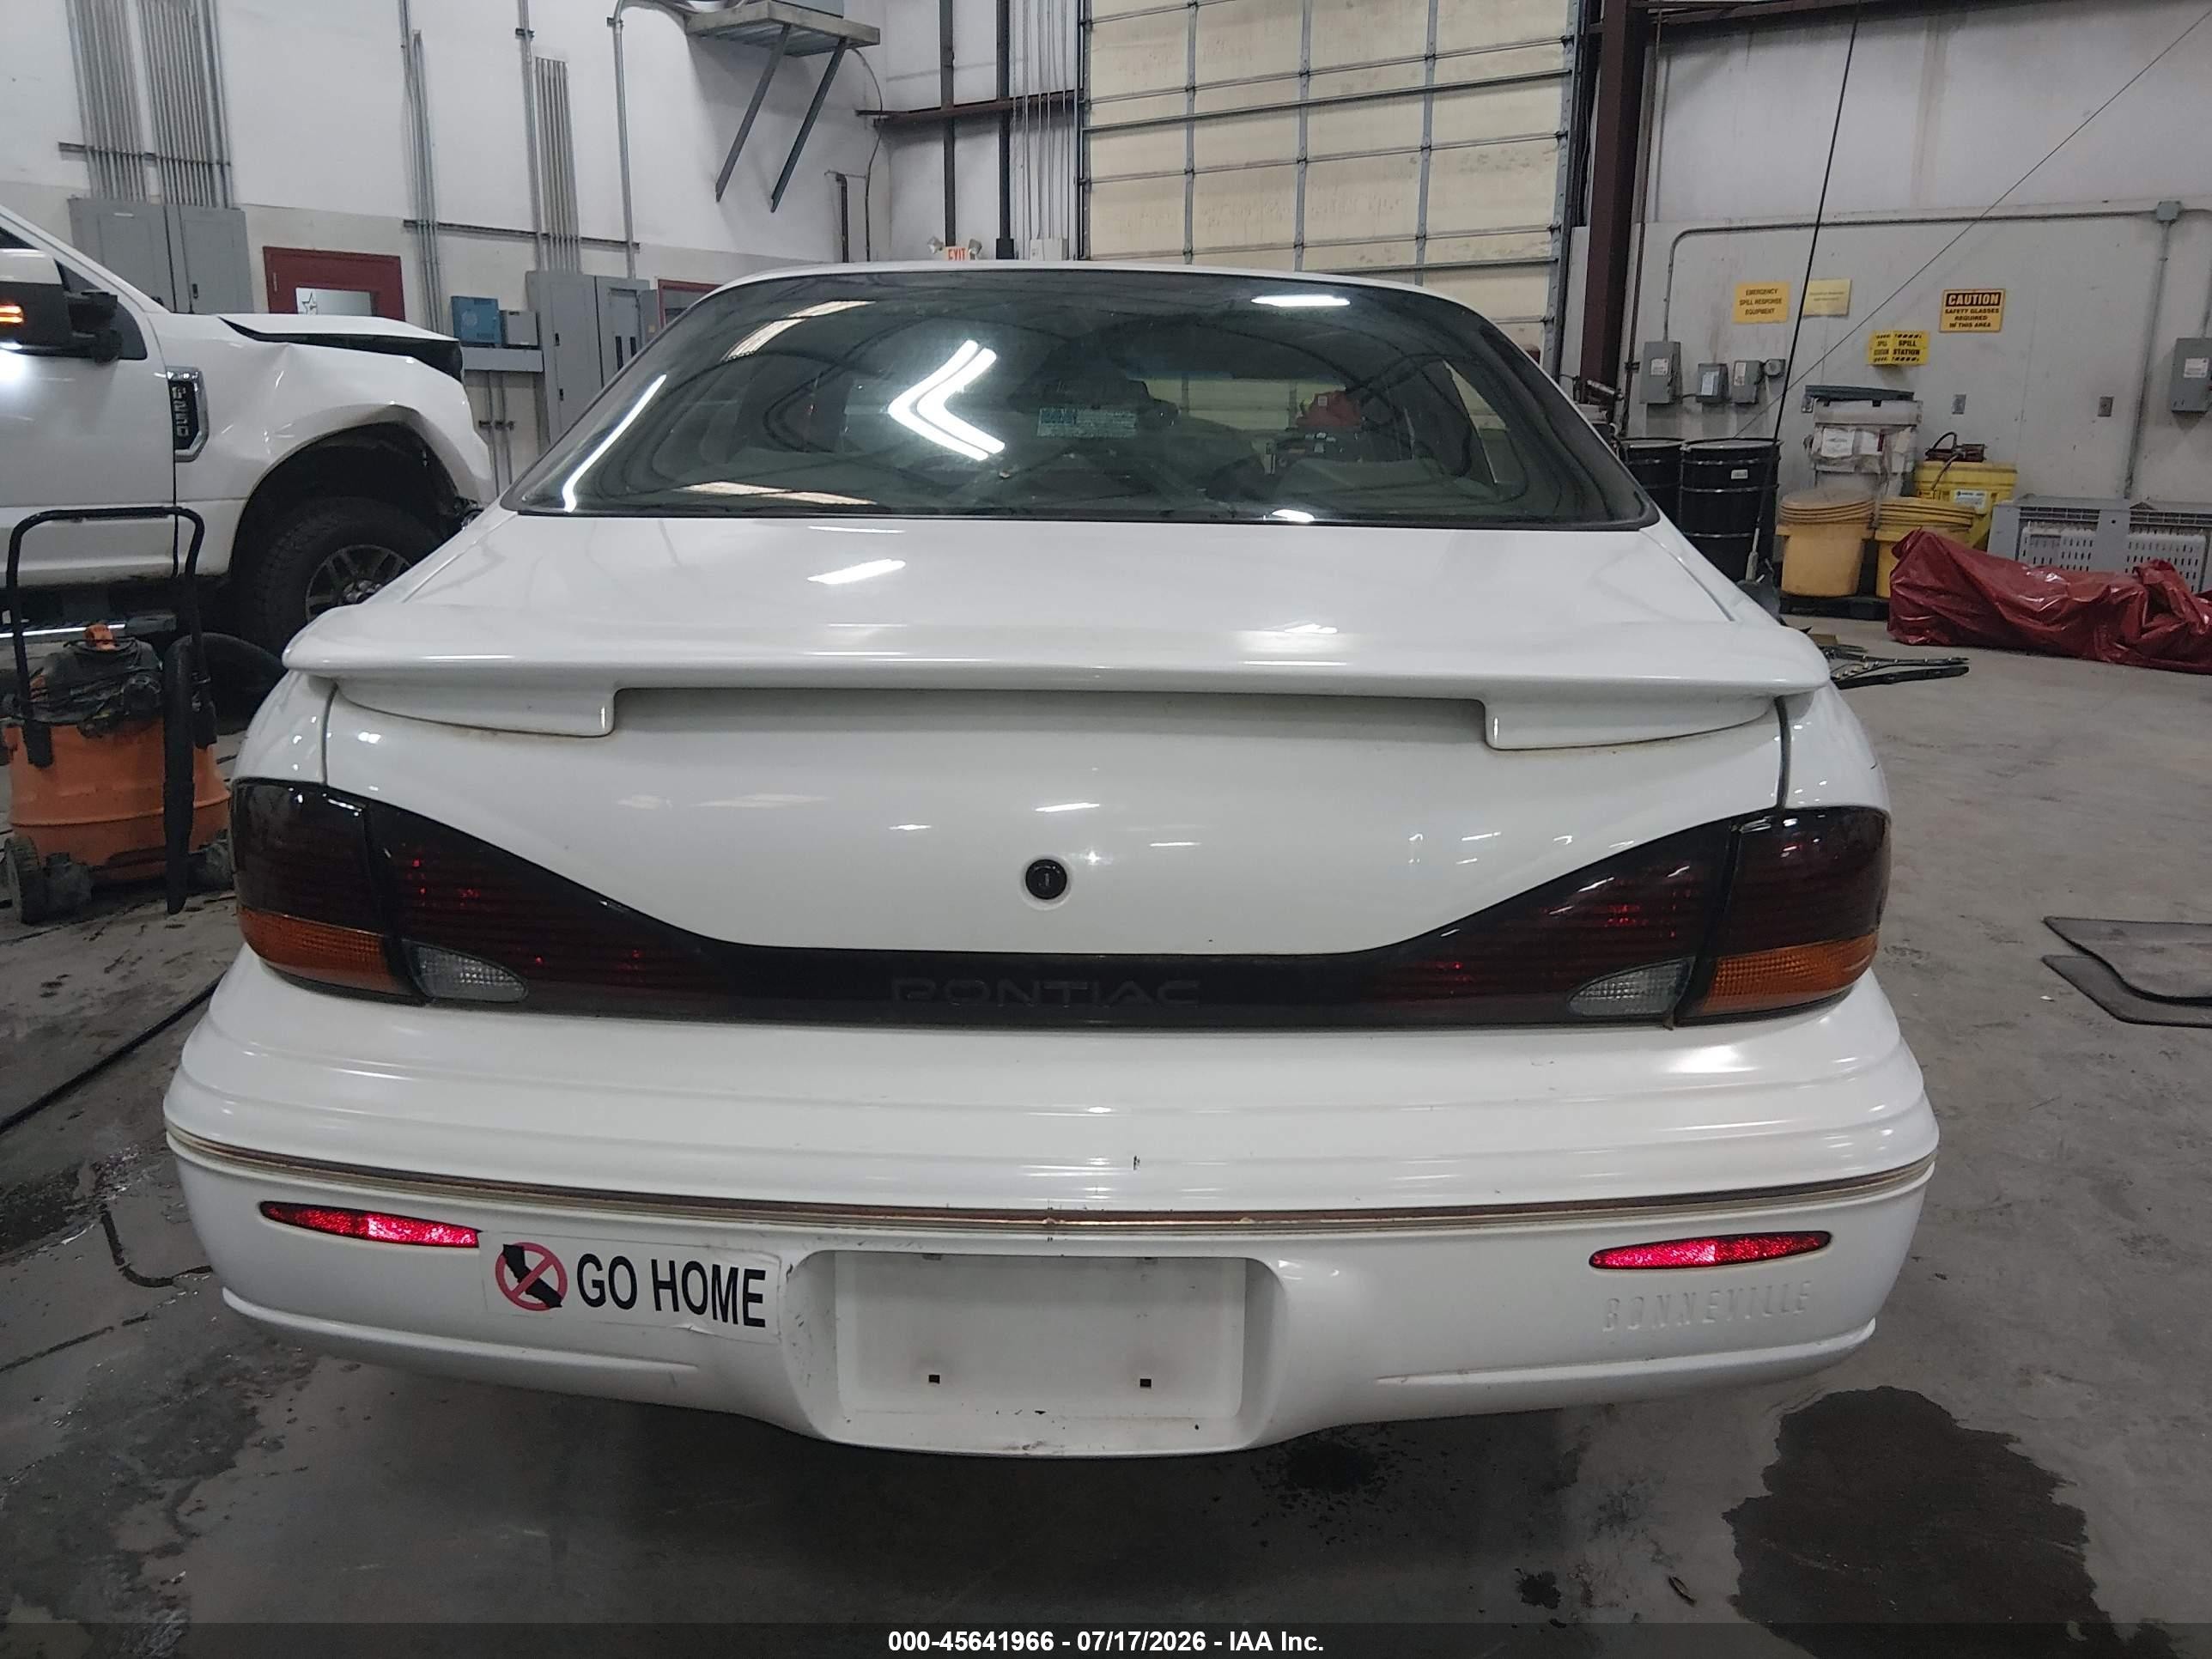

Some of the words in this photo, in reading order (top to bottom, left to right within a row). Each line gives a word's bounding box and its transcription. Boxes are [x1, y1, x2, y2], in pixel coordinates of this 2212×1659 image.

[948, 248, 966, 261] EXIT
[1948, 294, 2000, 306] CAUTION
[890, 976, 1202, 1010] PONTIAC
[576, 1252, 639, 1311] GO
[650, 1257, 767, 1328] HOME
[1602, 1280, 1814, 1332] BONNEVILLE
